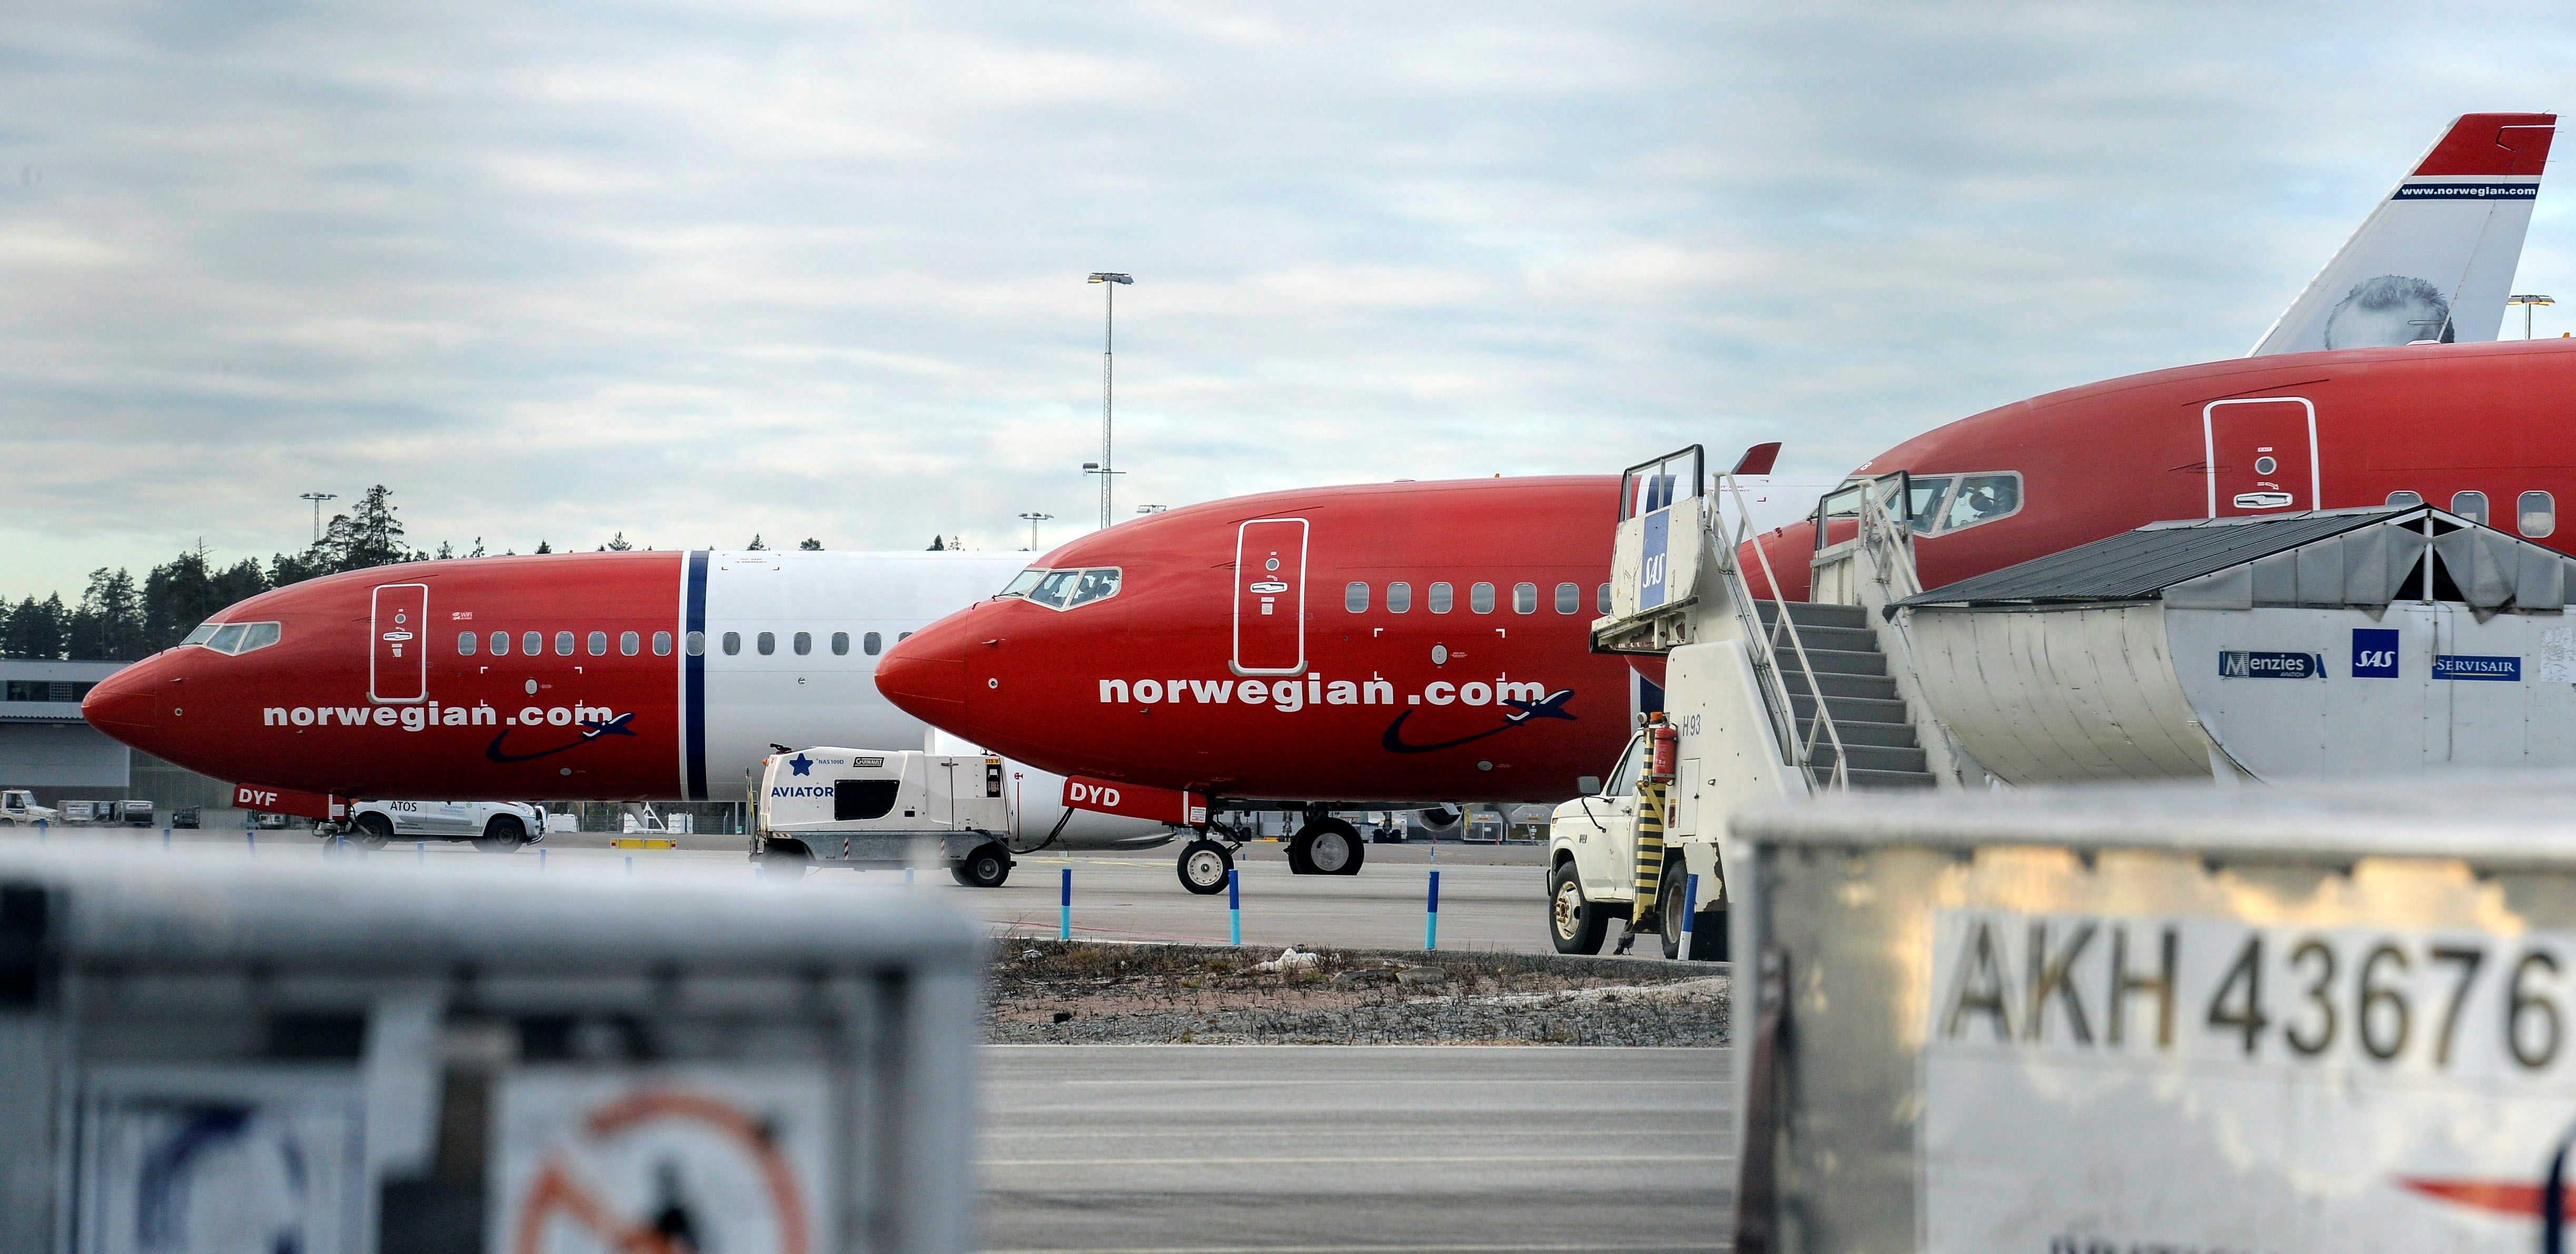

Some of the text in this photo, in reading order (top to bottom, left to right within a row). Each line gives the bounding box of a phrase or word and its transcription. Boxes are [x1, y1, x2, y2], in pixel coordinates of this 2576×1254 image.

[2402, 187, 2535, 196] www.norwegian.com
[1642, 553, 1665, 588] SAS
[2226, 654, 2304, 675] Menzies
[2355, 651, 2396, 667] SAS
[2436, 659, 2515, 672] SERVISAIR
[1099, 672, 1394, 712] norwegian
[263, 701, 496, 731] norwegian
[239, 789, 278, 806] DYF
[771, 787, 834, 797] AVIATOR
[1070, 782, 1120, 807] DYD
[390, 801, 417, 812] ATOS
[1939, 918, 2562, 1069] AKH 43676
